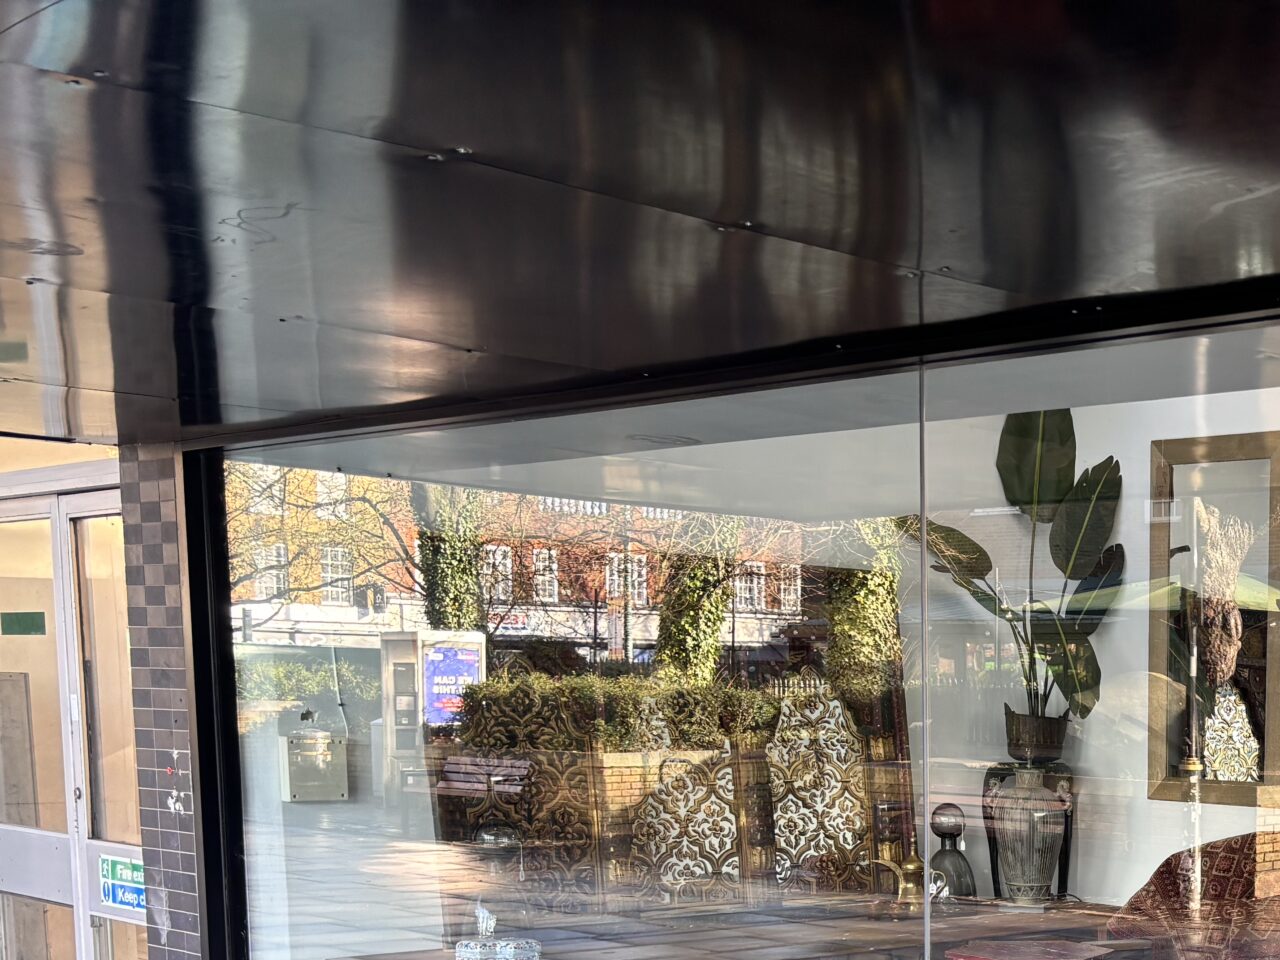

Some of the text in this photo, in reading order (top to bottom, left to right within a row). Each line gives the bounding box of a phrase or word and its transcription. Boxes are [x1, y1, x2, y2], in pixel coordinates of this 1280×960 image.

[117, 864, 144, 882] Fire exi
[118, 887, 138, 907] Keep
